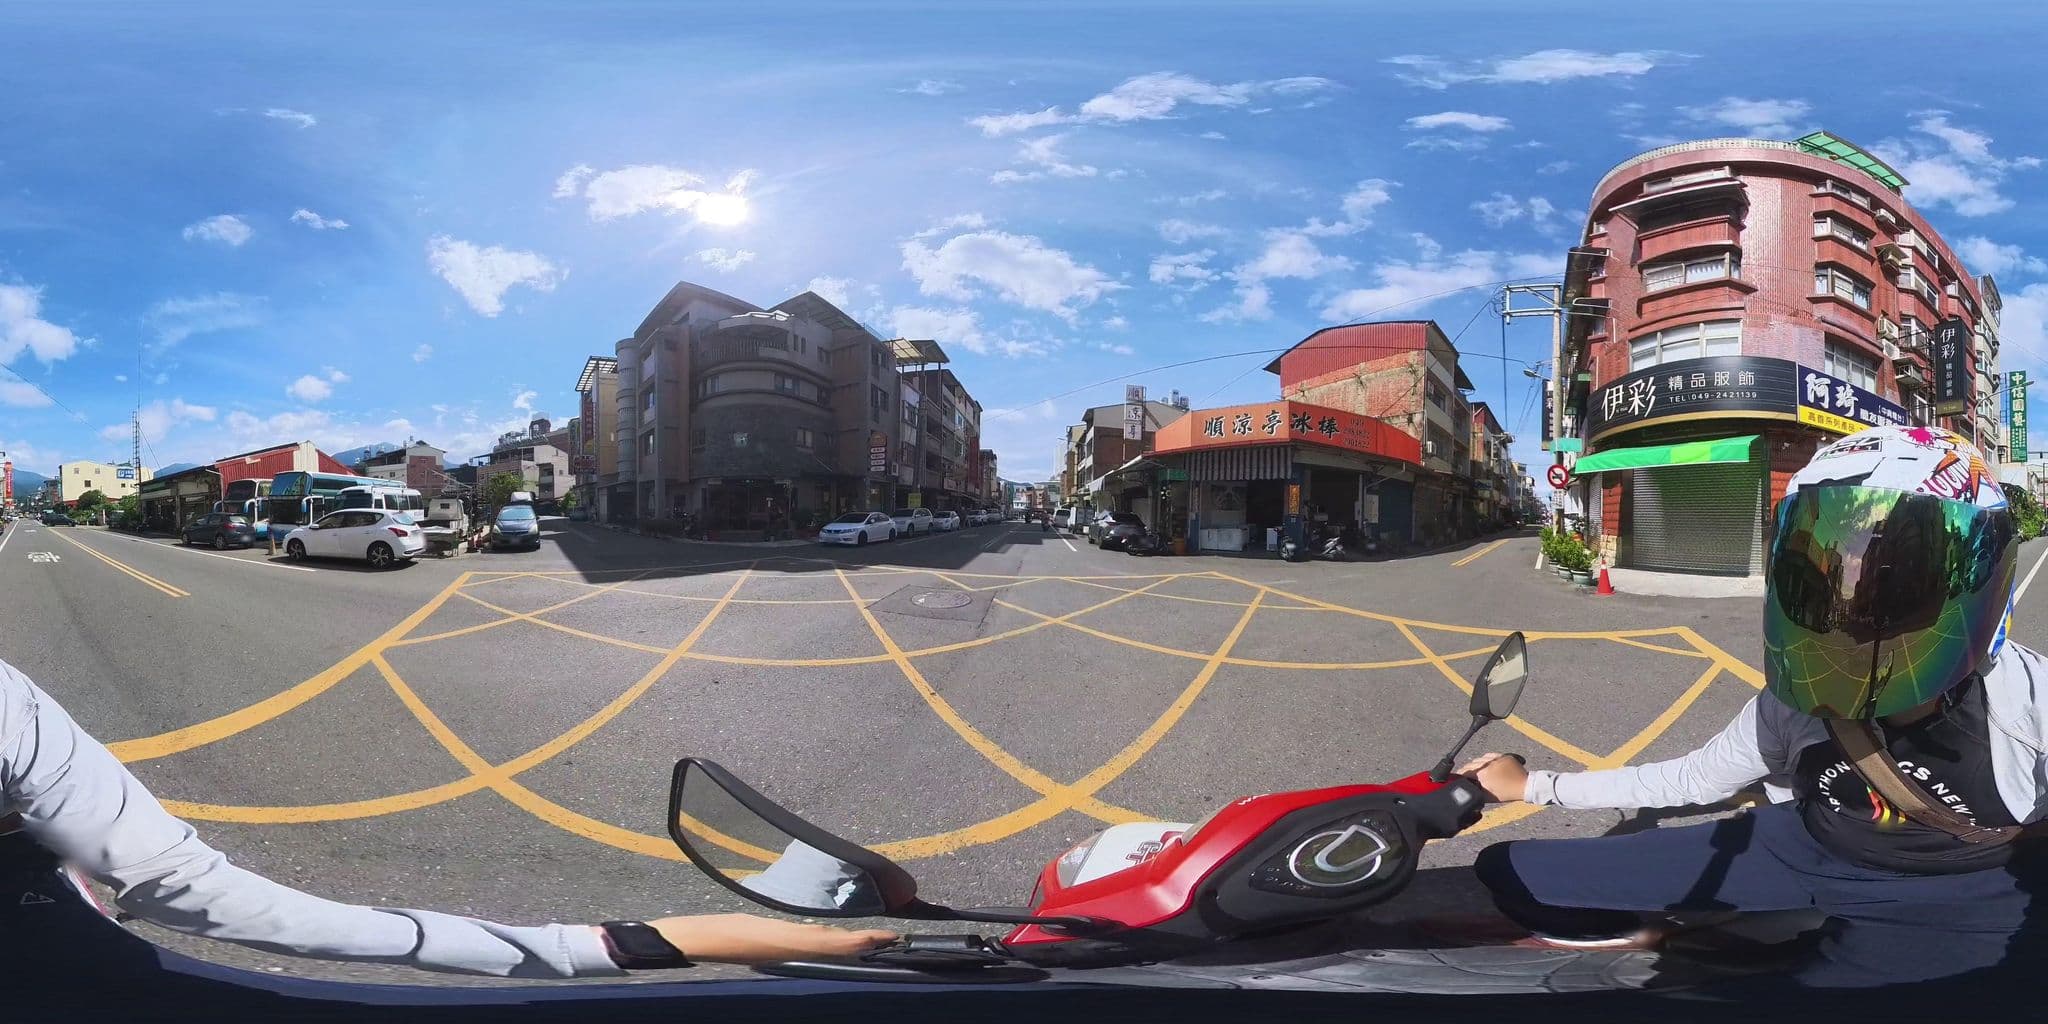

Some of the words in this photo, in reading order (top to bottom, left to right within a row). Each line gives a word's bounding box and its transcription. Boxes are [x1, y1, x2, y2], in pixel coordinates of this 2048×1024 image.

[1940, 328, 1955, 359] 伊彩
[1667, 370, 1755, 391] 精品服飾
[1601, 376, 1657, 421] 伊彩
[1931, 782, 1973, 815] NEW
